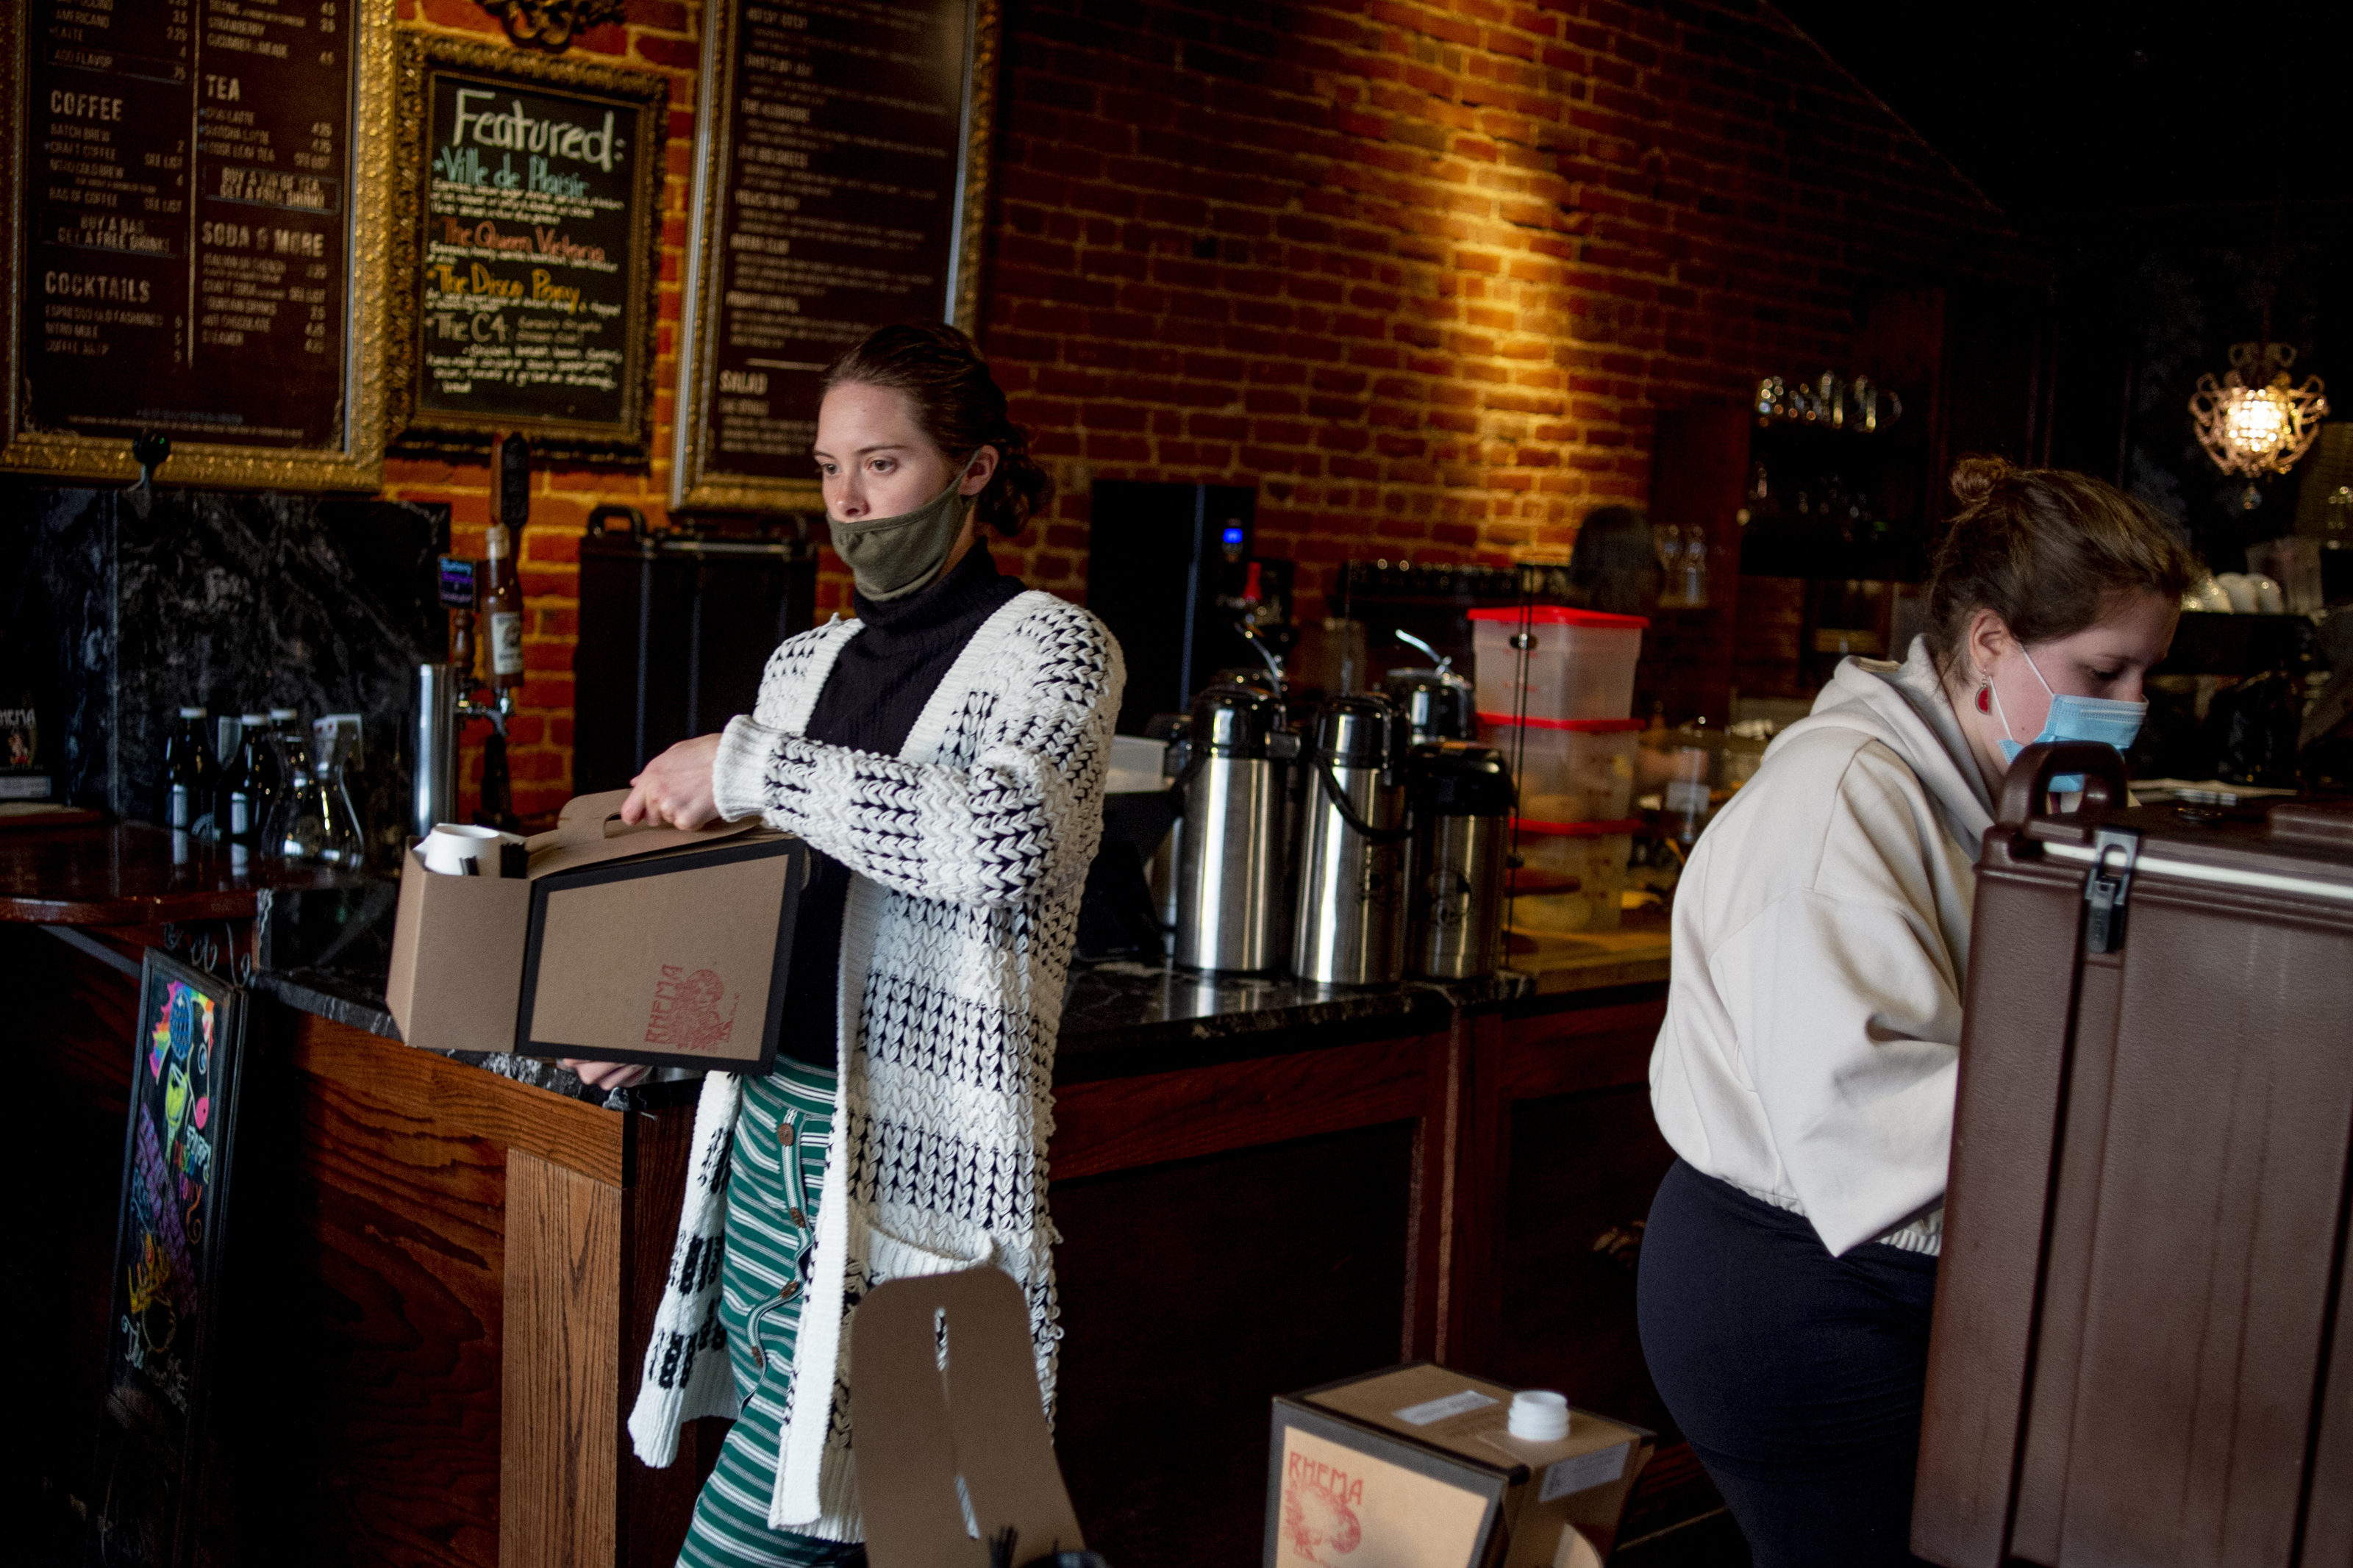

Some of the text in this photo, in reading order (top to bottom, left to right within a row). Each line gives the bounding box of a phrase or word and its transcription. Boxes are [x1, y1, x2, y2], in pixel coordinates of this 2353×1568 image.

[51, 89, 124, 121] COFFEE
[205, 74, 240, 102] TEA
[453, 87, 627, 173] Featured:
[441, 145, 591, 198] Ville de Plaisir
[84, 191, 118, 209] COFFEE
[201, 221, 251, 249] SODA
[274, 229, 325, 258] MORE
[441, 215, 605, 263] The Queen Victoria
[45, 270, 151, 304] COCKTAILS
[432, 262, 470, 296] The
[470, 262, 525, 298] Disco
[531, 268, 581, 316] Pony
[432, 312, 510, 343] The C4
[718, 368, 768, 397] SALAD
[644, 963, 685, 1045] RHEMA
[1287, 1450, 1363, 1507] RHEMA
